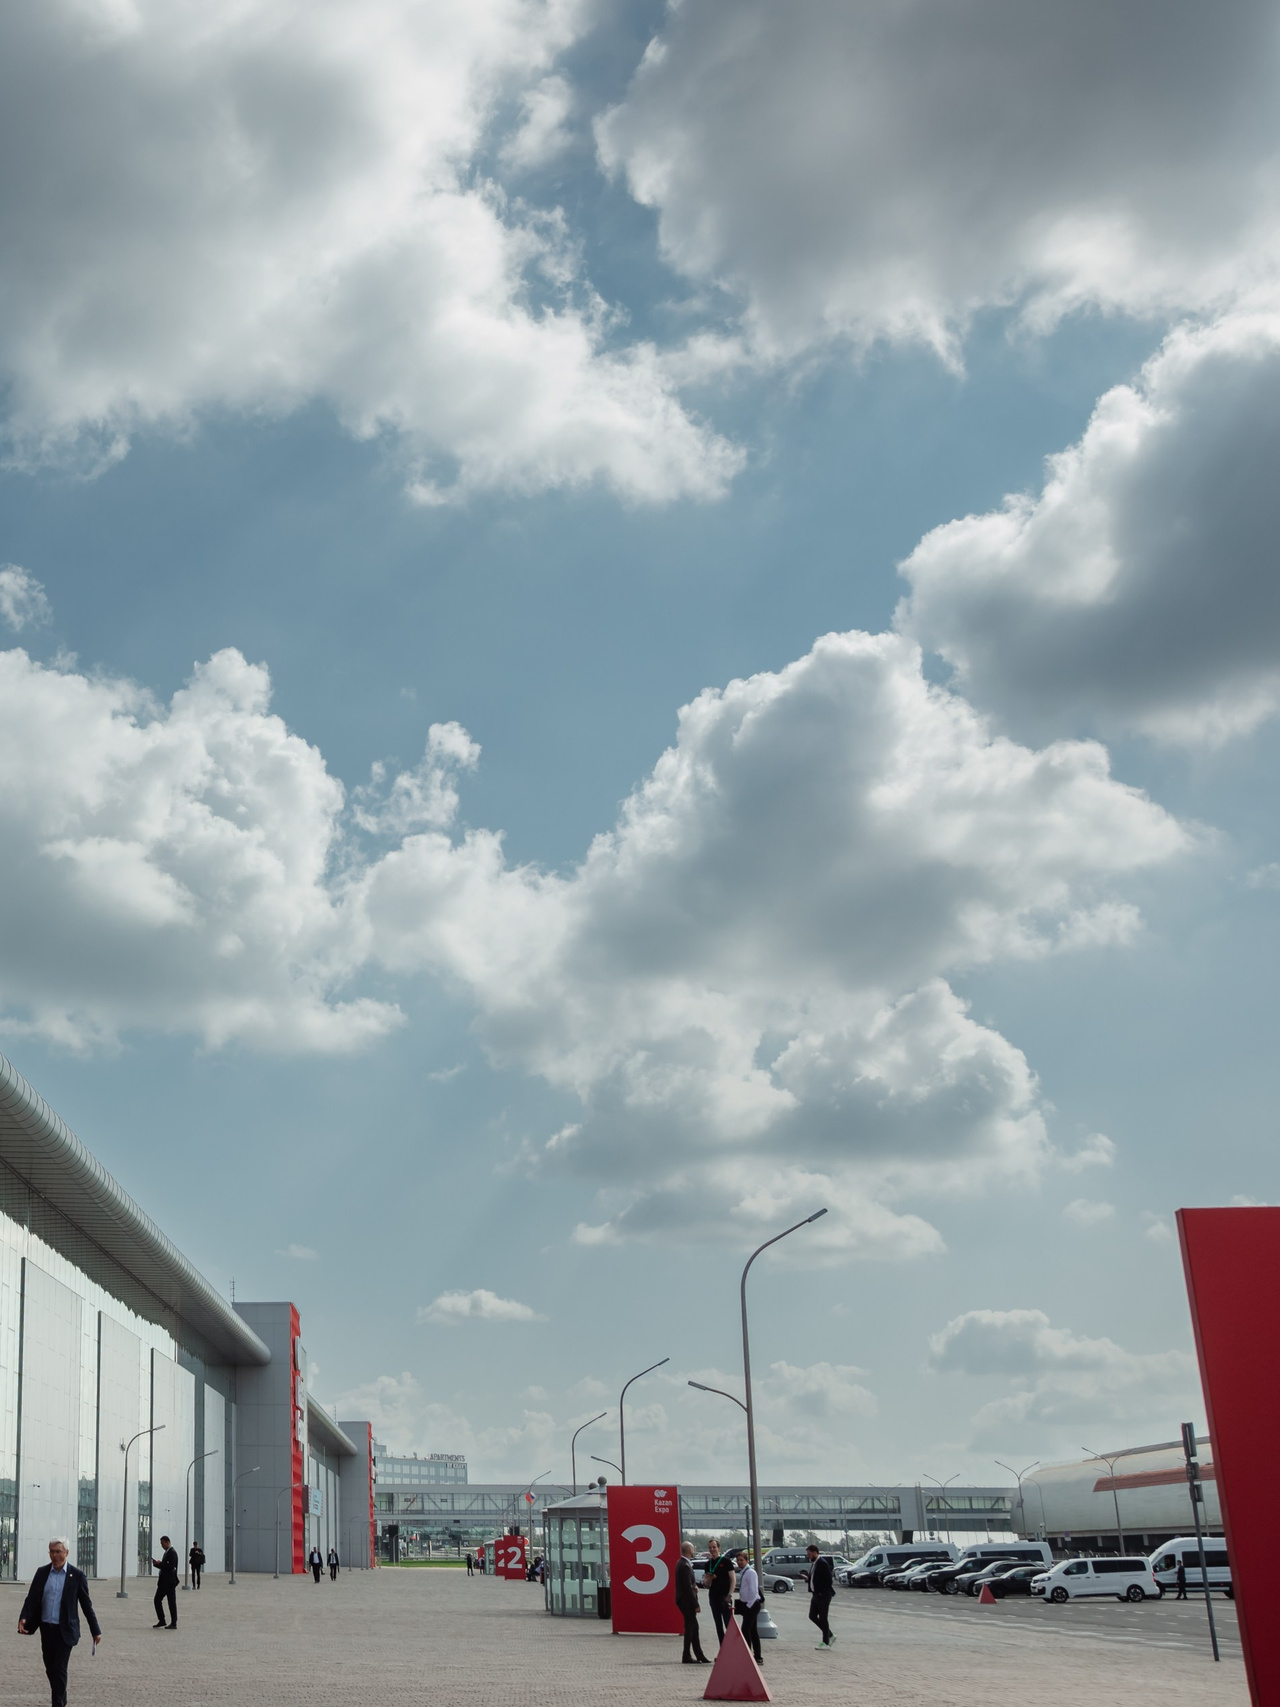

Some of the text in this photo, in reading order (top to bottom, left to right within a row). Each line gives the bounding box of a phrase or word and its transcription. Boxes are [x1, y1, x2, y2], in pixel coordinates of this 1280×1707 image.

[430, 1453, 466, 1462] APARTMENTS
[654, 1506, 670, 1514] Expo
[507, 1546, 523, 1569] 2
[621, 1524, 669, 1595] 3
